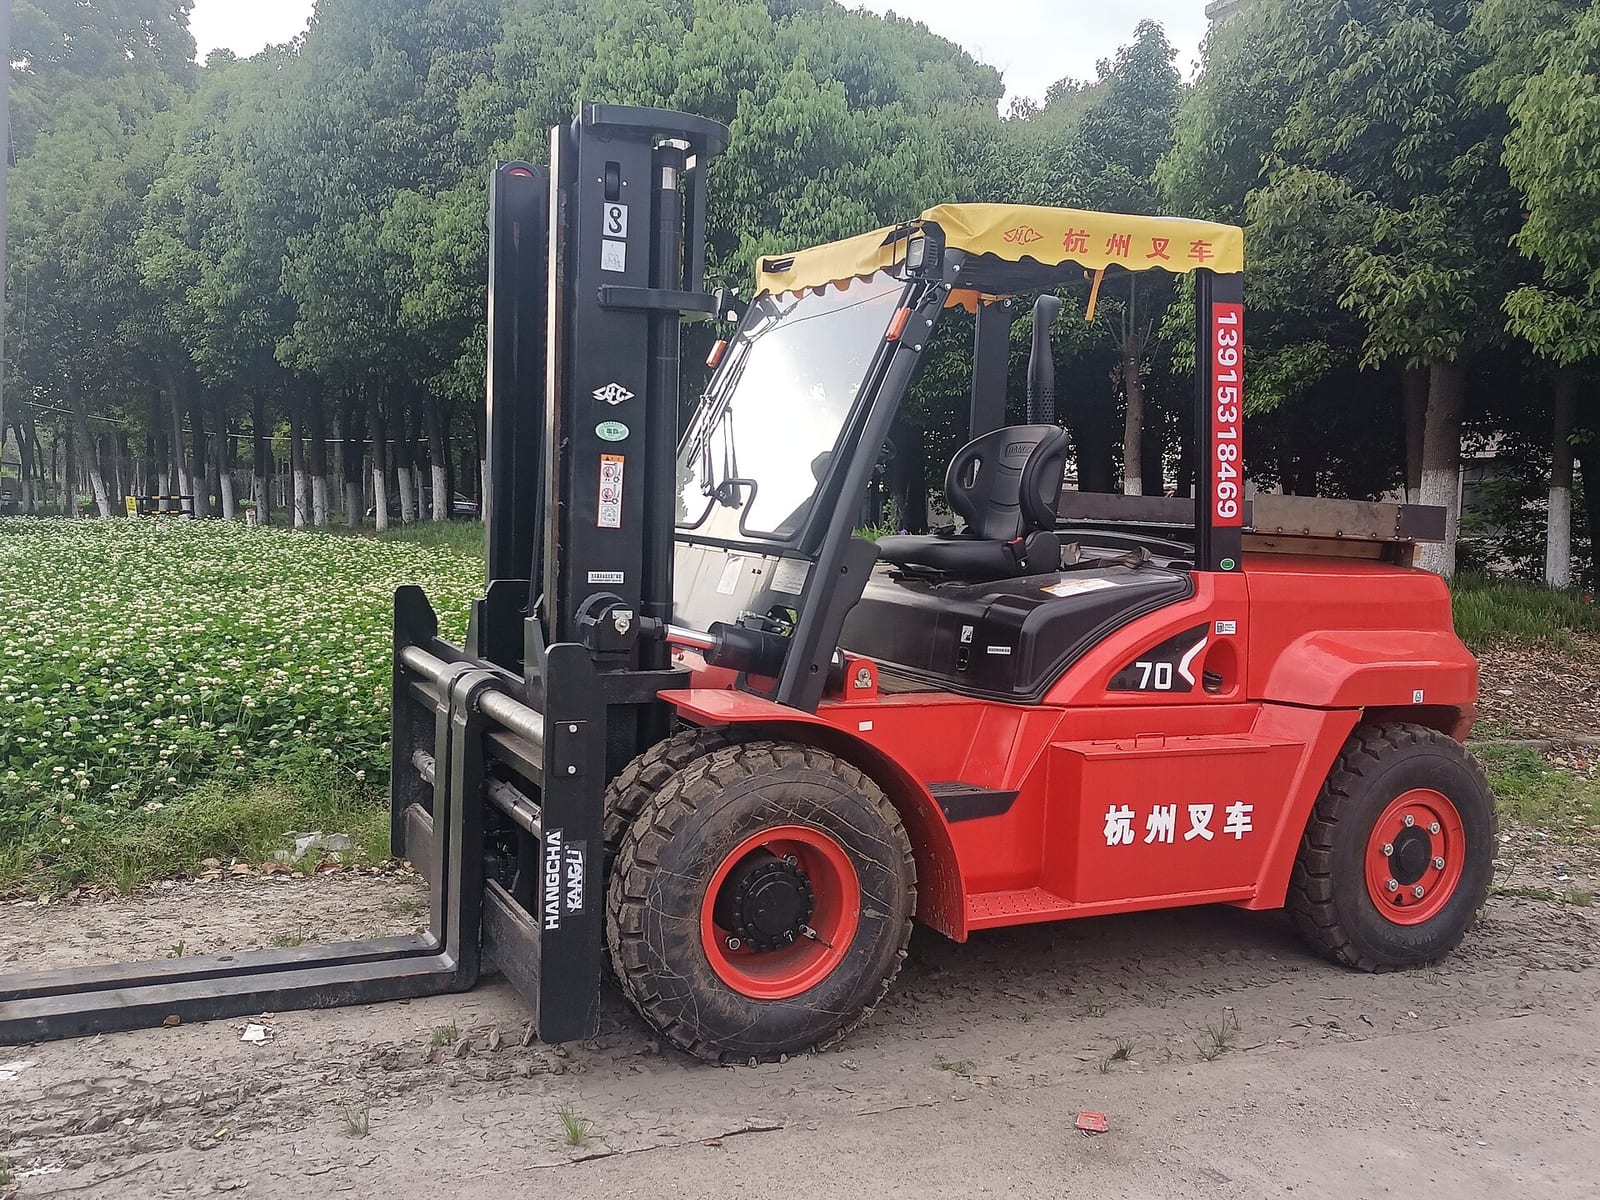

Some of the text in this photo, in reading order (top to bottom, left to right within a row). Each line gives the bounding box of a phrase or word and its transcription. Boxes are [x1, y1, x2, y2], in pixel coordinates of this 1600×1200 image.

[1063, 228, 1214, 262] 杭州叉车
[1217, 312, 1237, 518] 13915318469
[1136, 662, 1173, 689] 70
[1103, 801, 1253, 846] 杭州叉车
[545, 831, 561, 930] HANGCHA
